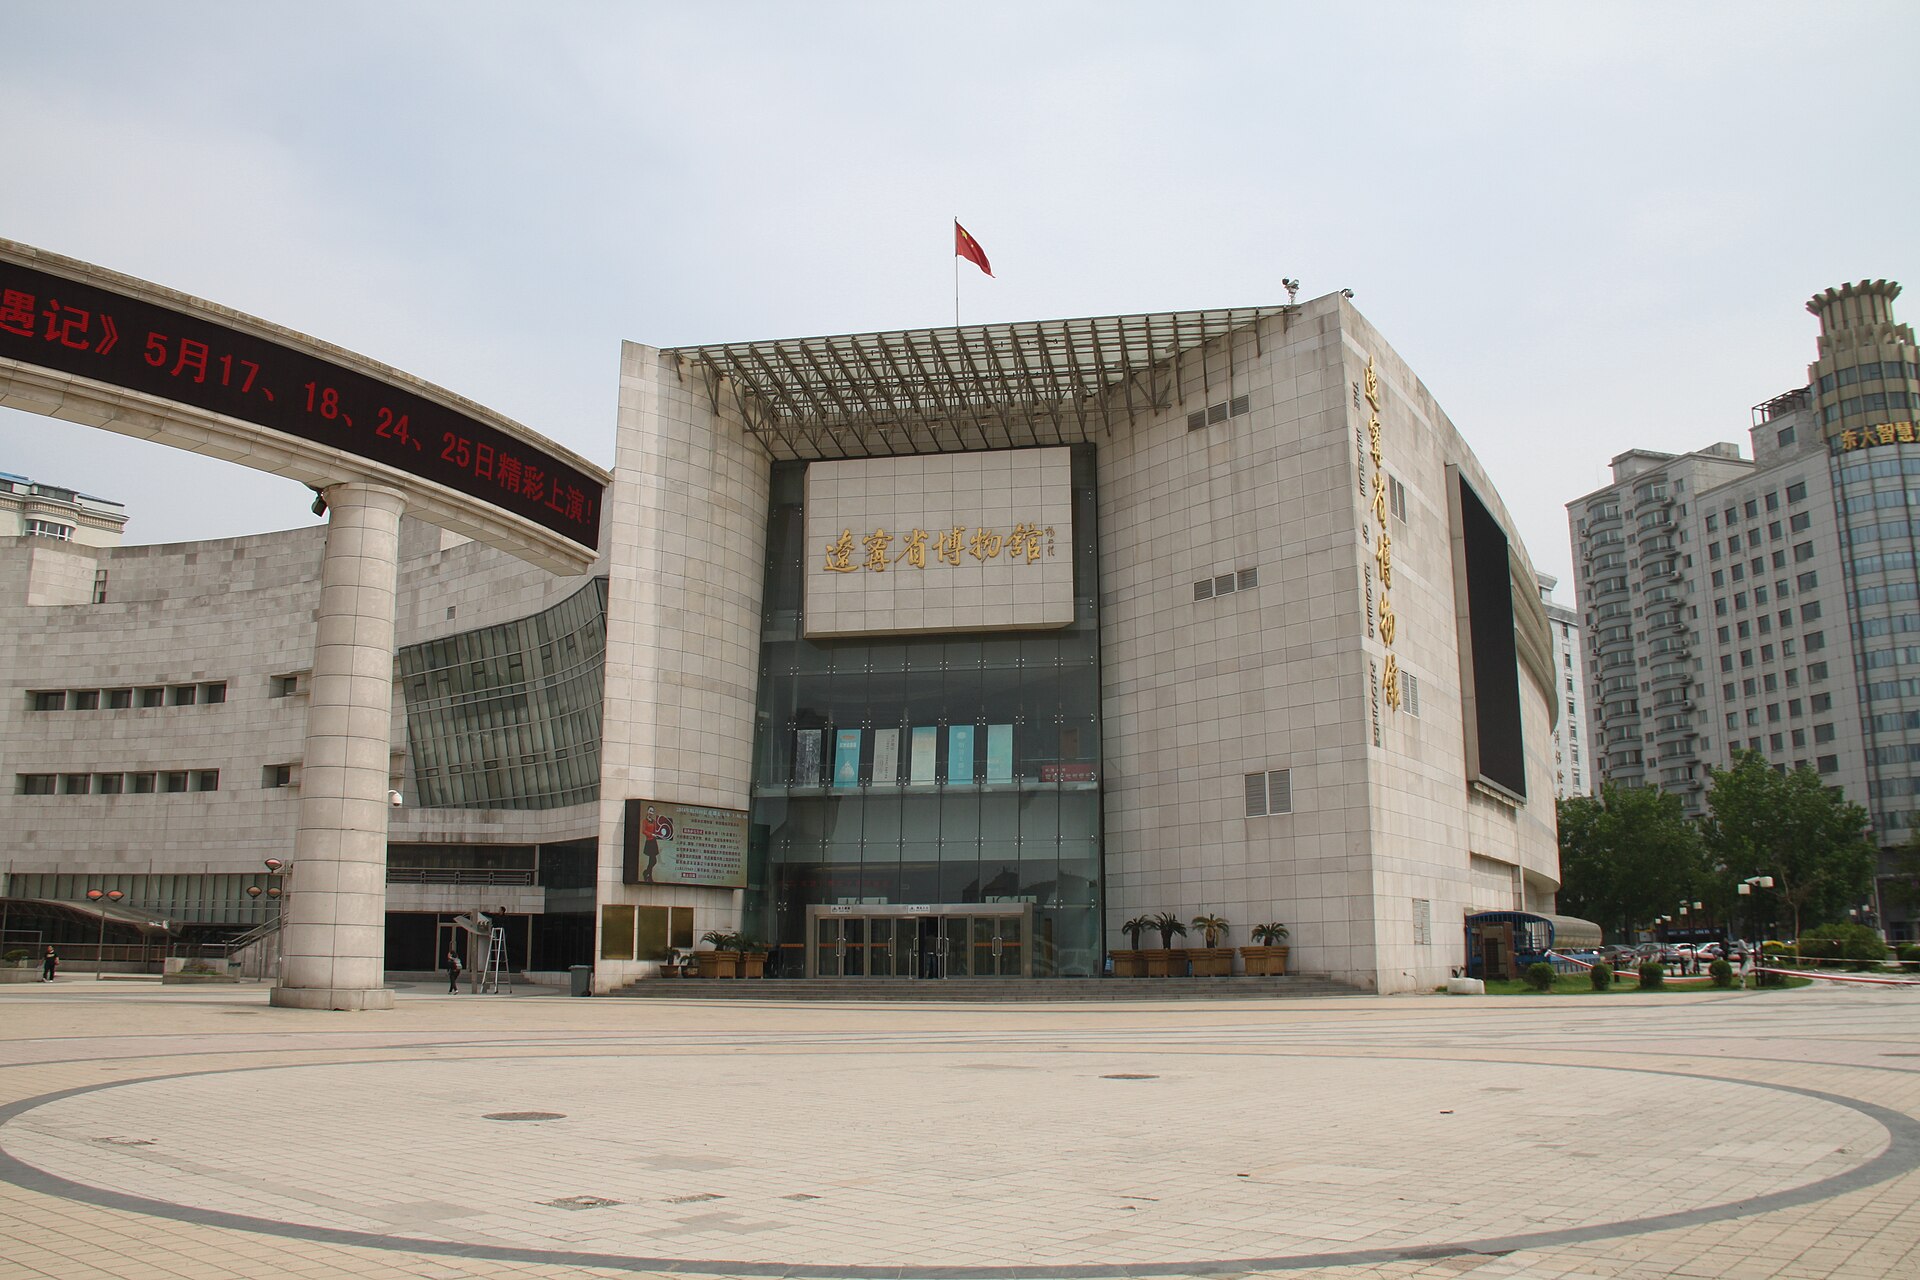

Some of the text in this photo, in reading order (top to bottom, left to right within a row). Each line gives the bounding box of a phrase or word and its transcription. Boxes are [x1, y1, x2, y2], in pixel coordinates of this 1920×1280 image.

[1352, 380, 1381, 748] THE MUSEUM OF LIAONING PROVINCE
